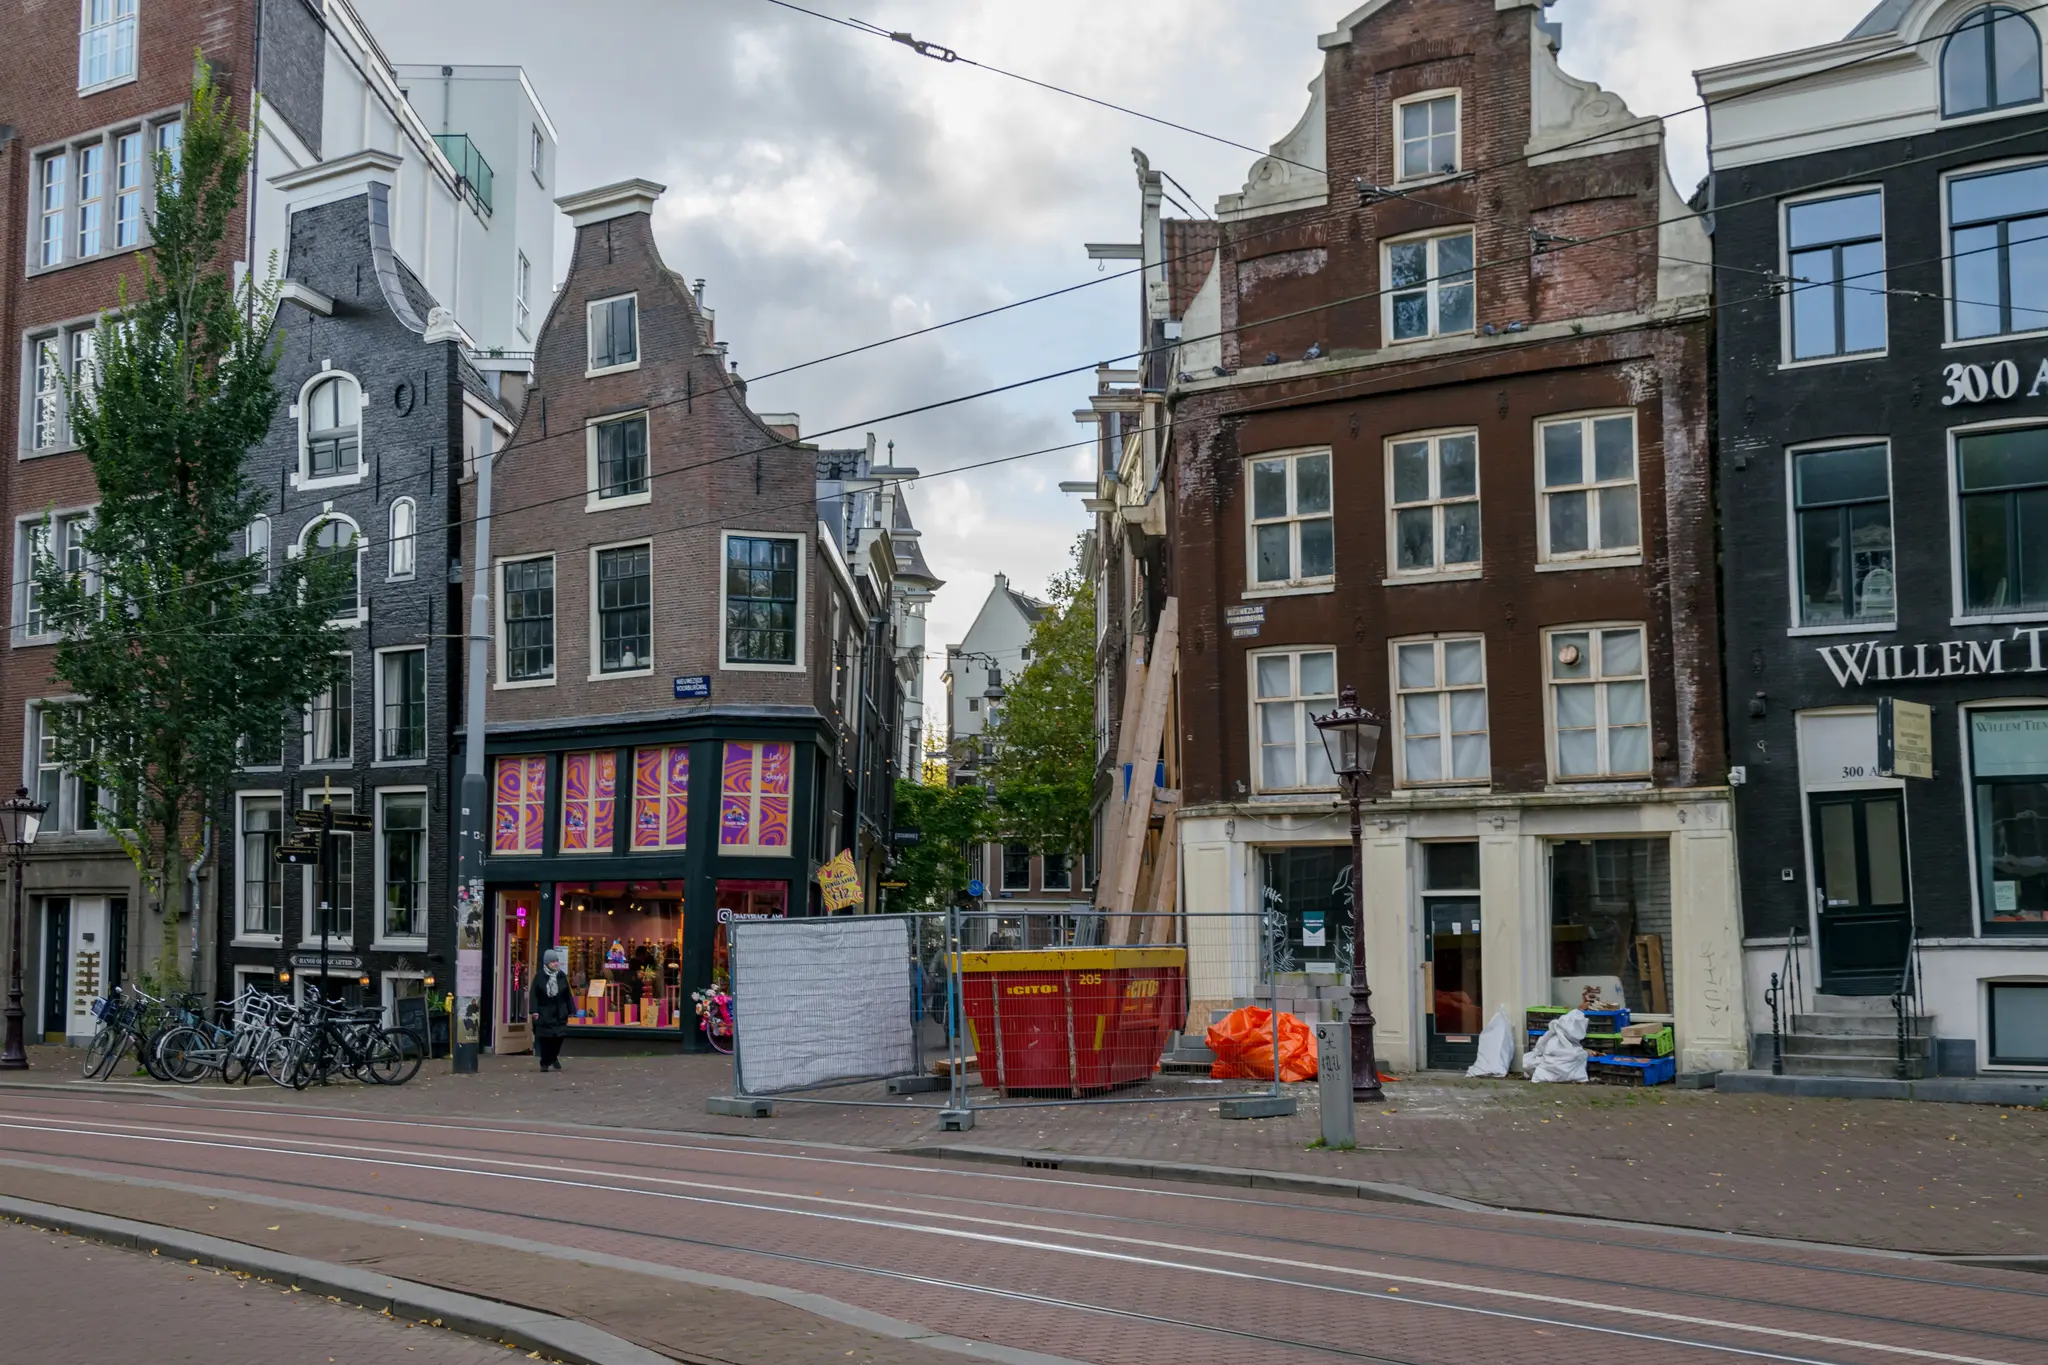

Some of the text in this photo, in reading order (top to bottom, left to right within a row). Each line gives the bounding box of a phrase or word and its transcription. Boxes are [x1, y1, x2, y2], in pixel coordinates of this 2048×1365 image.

[1941, 360, 2019, 405] 300
[1816, 640, 2004, 688] WILLEM
[1975, 722, 2021, 732] WILLEM
[1842, 766, 1864, 779] 300
[1079, 974, 1102, 985] 205
[1012, 984, 1052, 995] CITO
[1131, 979, 1155, 999] CITO
